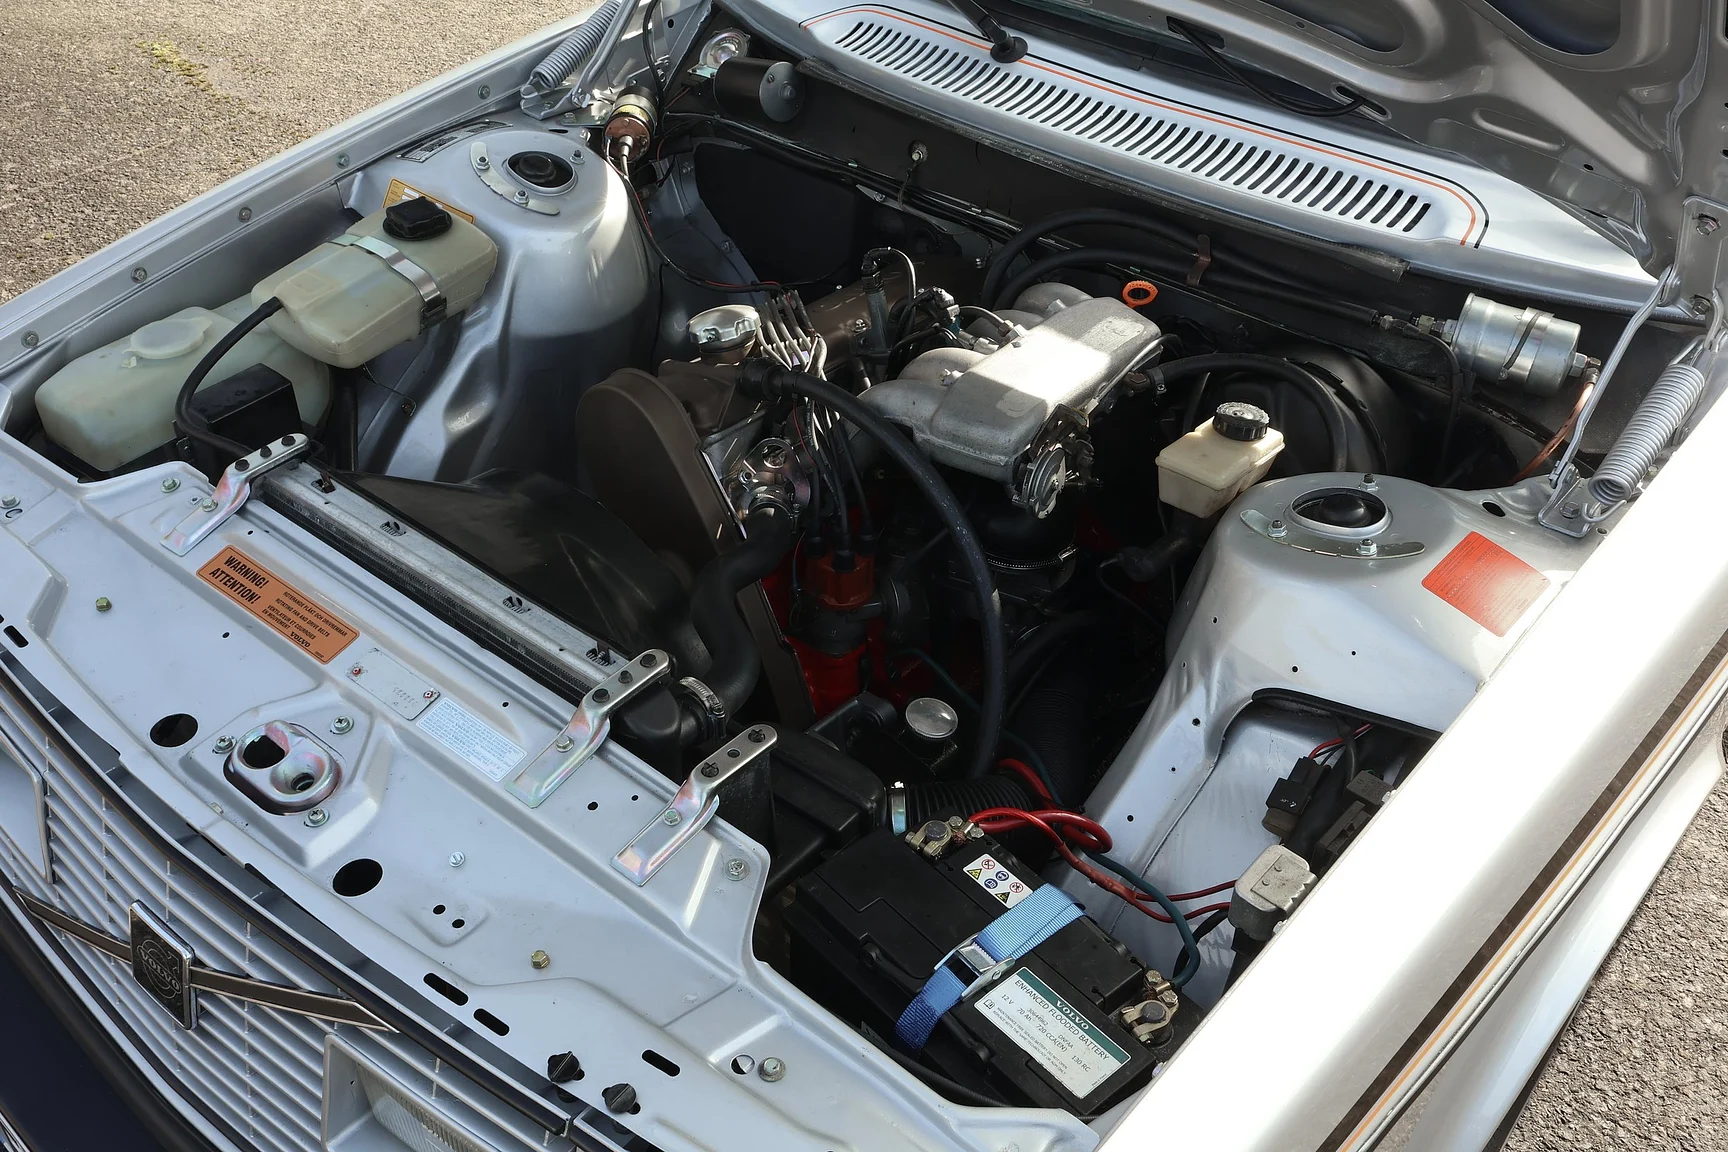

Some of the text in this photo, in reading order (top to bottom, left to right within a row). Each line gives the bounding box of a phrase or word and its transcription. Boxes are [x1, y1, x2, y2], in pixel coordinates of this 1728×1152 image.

[209, 566, 261, 604] ATTENTION!
[223, 555, 269, 589] WARNING!
[275, 597, 293, 611] ROTATING
[298, 614, 308, 622] AND
[307, 619, 319, 629] DRIVE
[317, 627, 330, 637] BELTS
[283, 591, 304, 607] ROTERANDE
[267, 612, 290, 629] MOUVEMENT
[267, 604, 291, 622] VENTILATEUR
[294, 623, 316, 640] COURROIES
[289, 631, 311, 647] VOLVO
[140, 948, 179, 990] VOLVO
[1015, 980, 1110, 1061] ENHANCED FLOODED BATTERY
[1055, 1000, 1090, 1030] VOLVO
[1016, 1007, 1026, 1015] 70
[1023, 1013, 1033, 1021] Ah
[1035, 1023, 1047, 1033] 720
[1071, 1054, 1082, 1065] 130
[1080, 1063, 1091, 1072] RC
